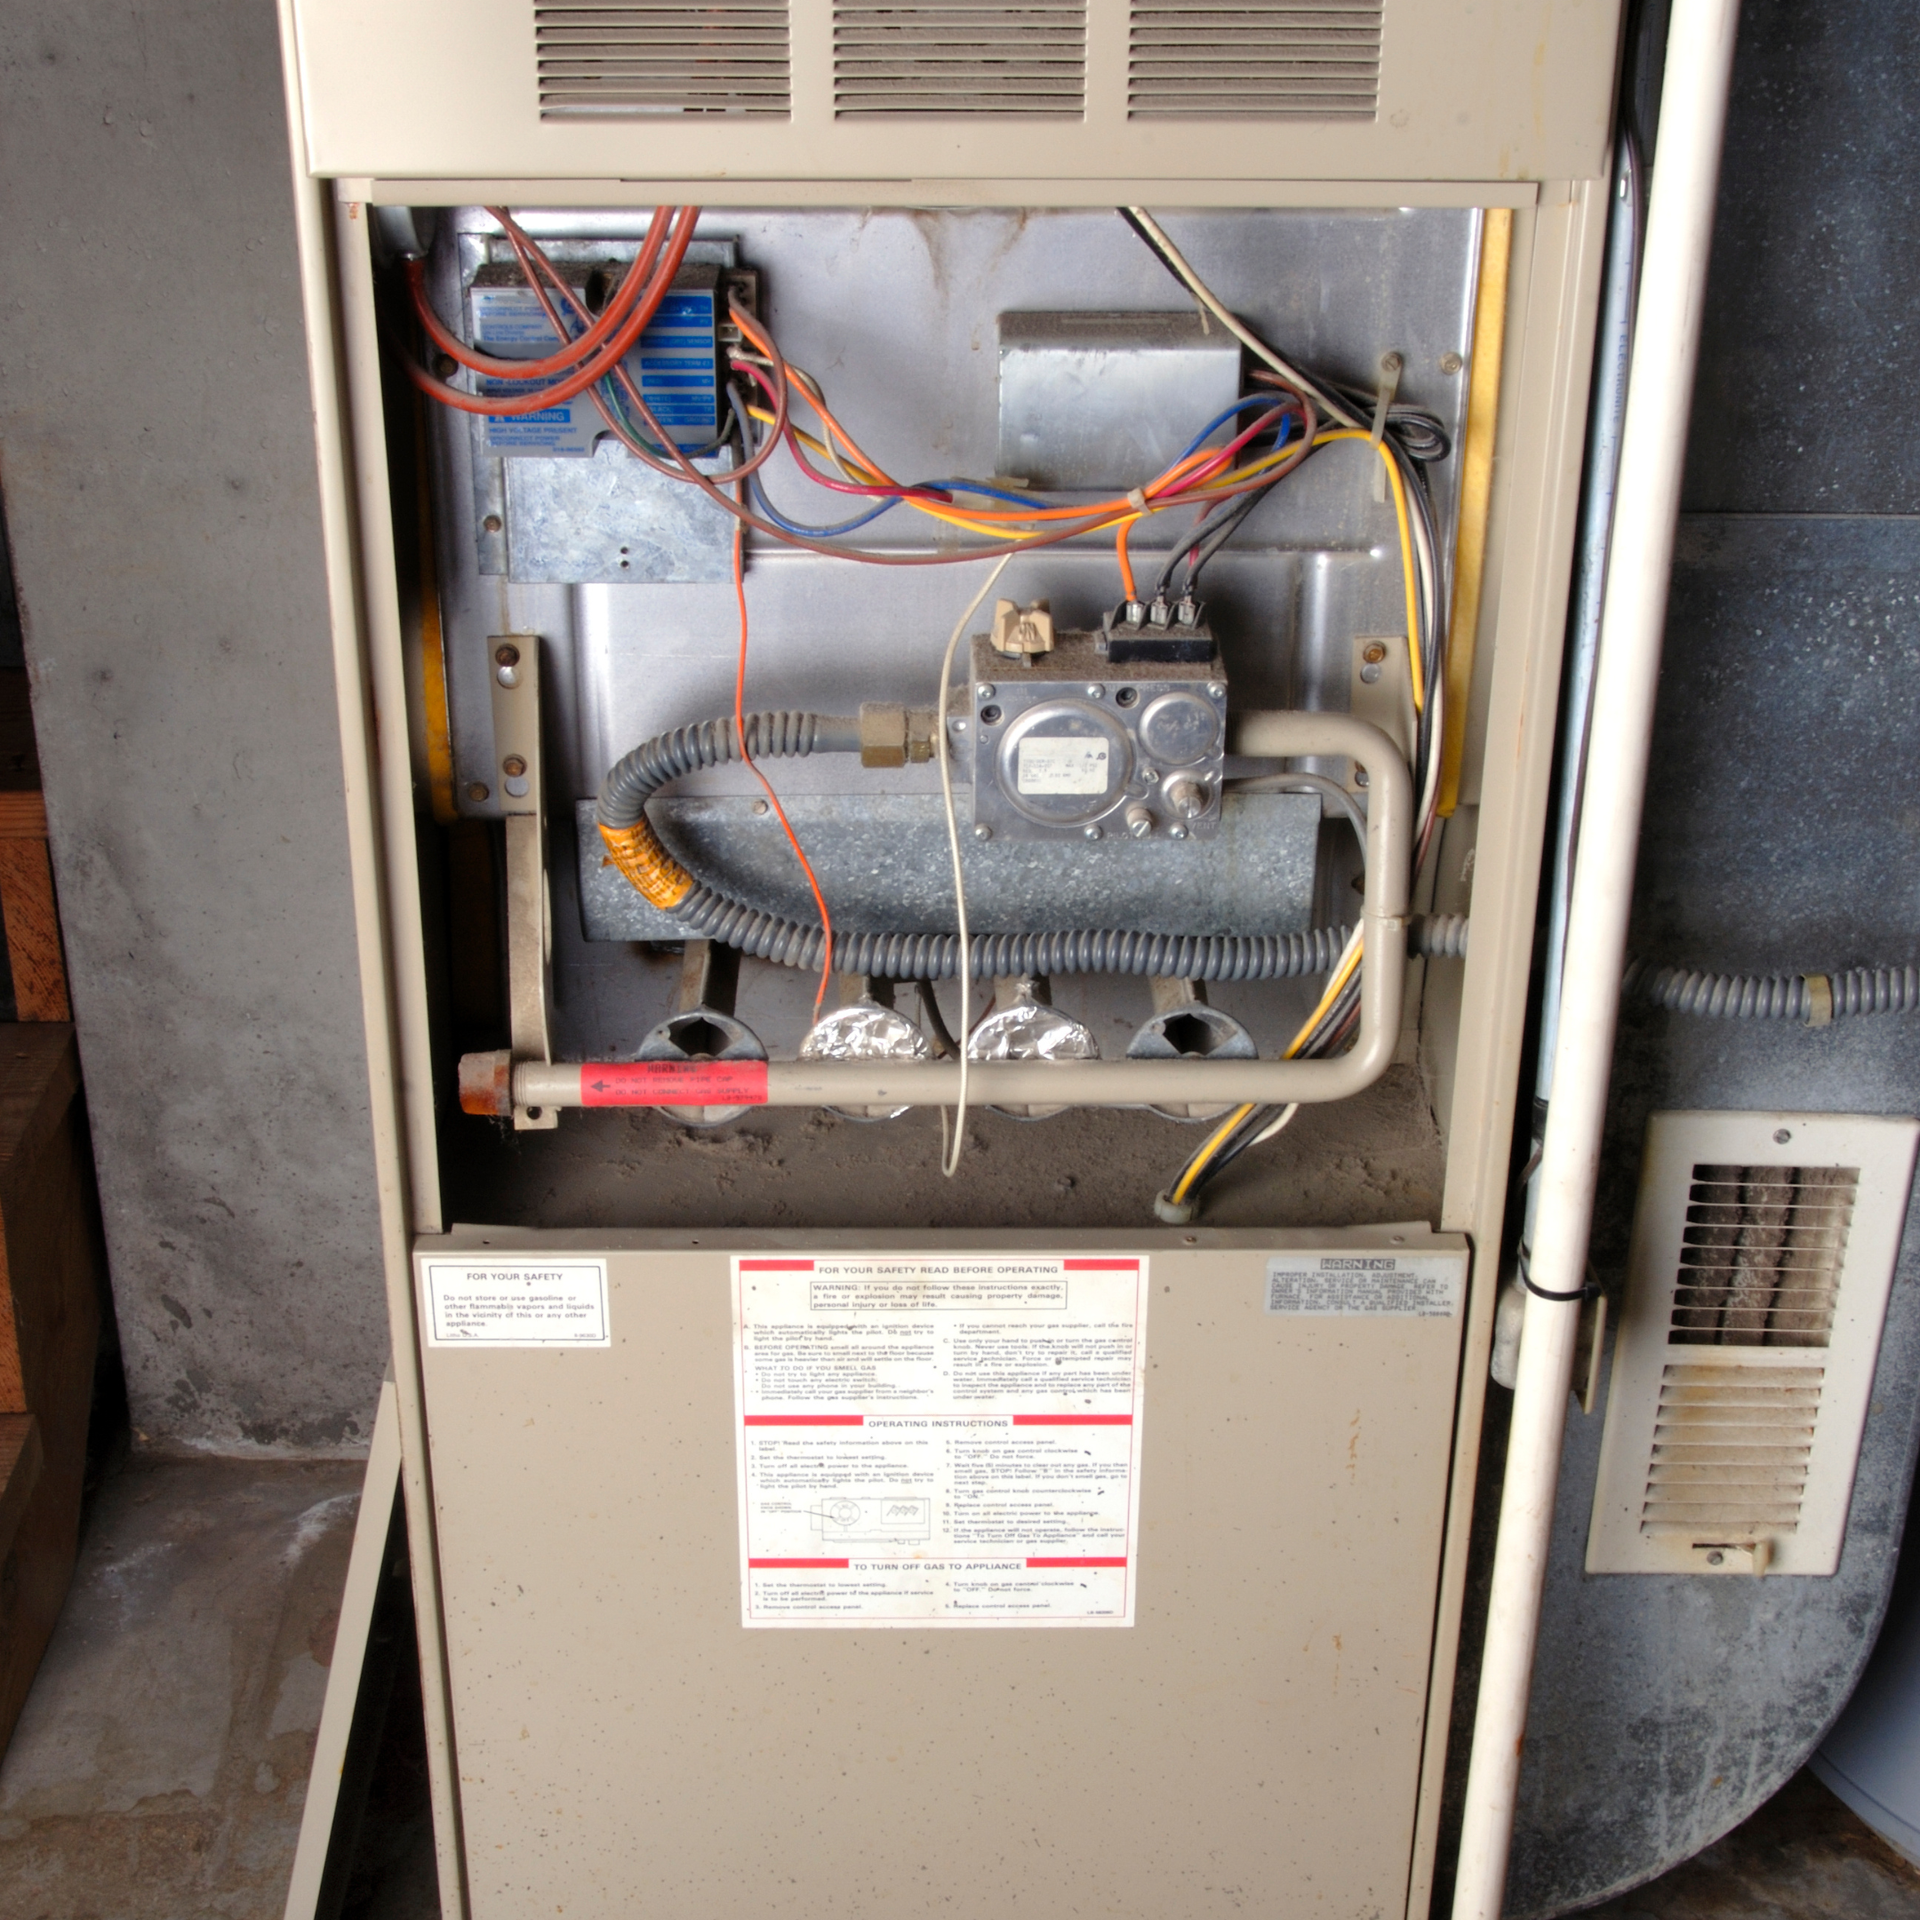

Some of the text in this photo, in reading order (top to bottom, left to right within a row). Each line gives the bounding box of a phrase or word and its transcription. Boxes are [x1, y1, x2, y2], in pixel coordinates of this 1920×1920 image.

[1321, 1259, 1394, 1270] WARNING
[819, 1266, 1059, 1274] FOR YOUR SAFETY READ BEFORE OPERATING
[467, 1273, 563, 1281] FOR YOUR SAFETY
[1031, 1284, 1064, 1292] exactly,
[529, 1295, 564, 1303] gasoline
[854, 1293, 896, 1301] explosion
[950, 1293, 983, 1301] causing
[987, 1293, 1023, 1301] property
[1027, 1293, 1063, 1301] damage,
[566, 1303, 595, 1311] liquids
[813, 1302, 850, 1310] personal
[852, 1302, 876, 1310] injury
[472, 1312, 503, 1320] vicinity
[868, 1420, 1009, 1428] OPERATING INSTRUCTIONS
